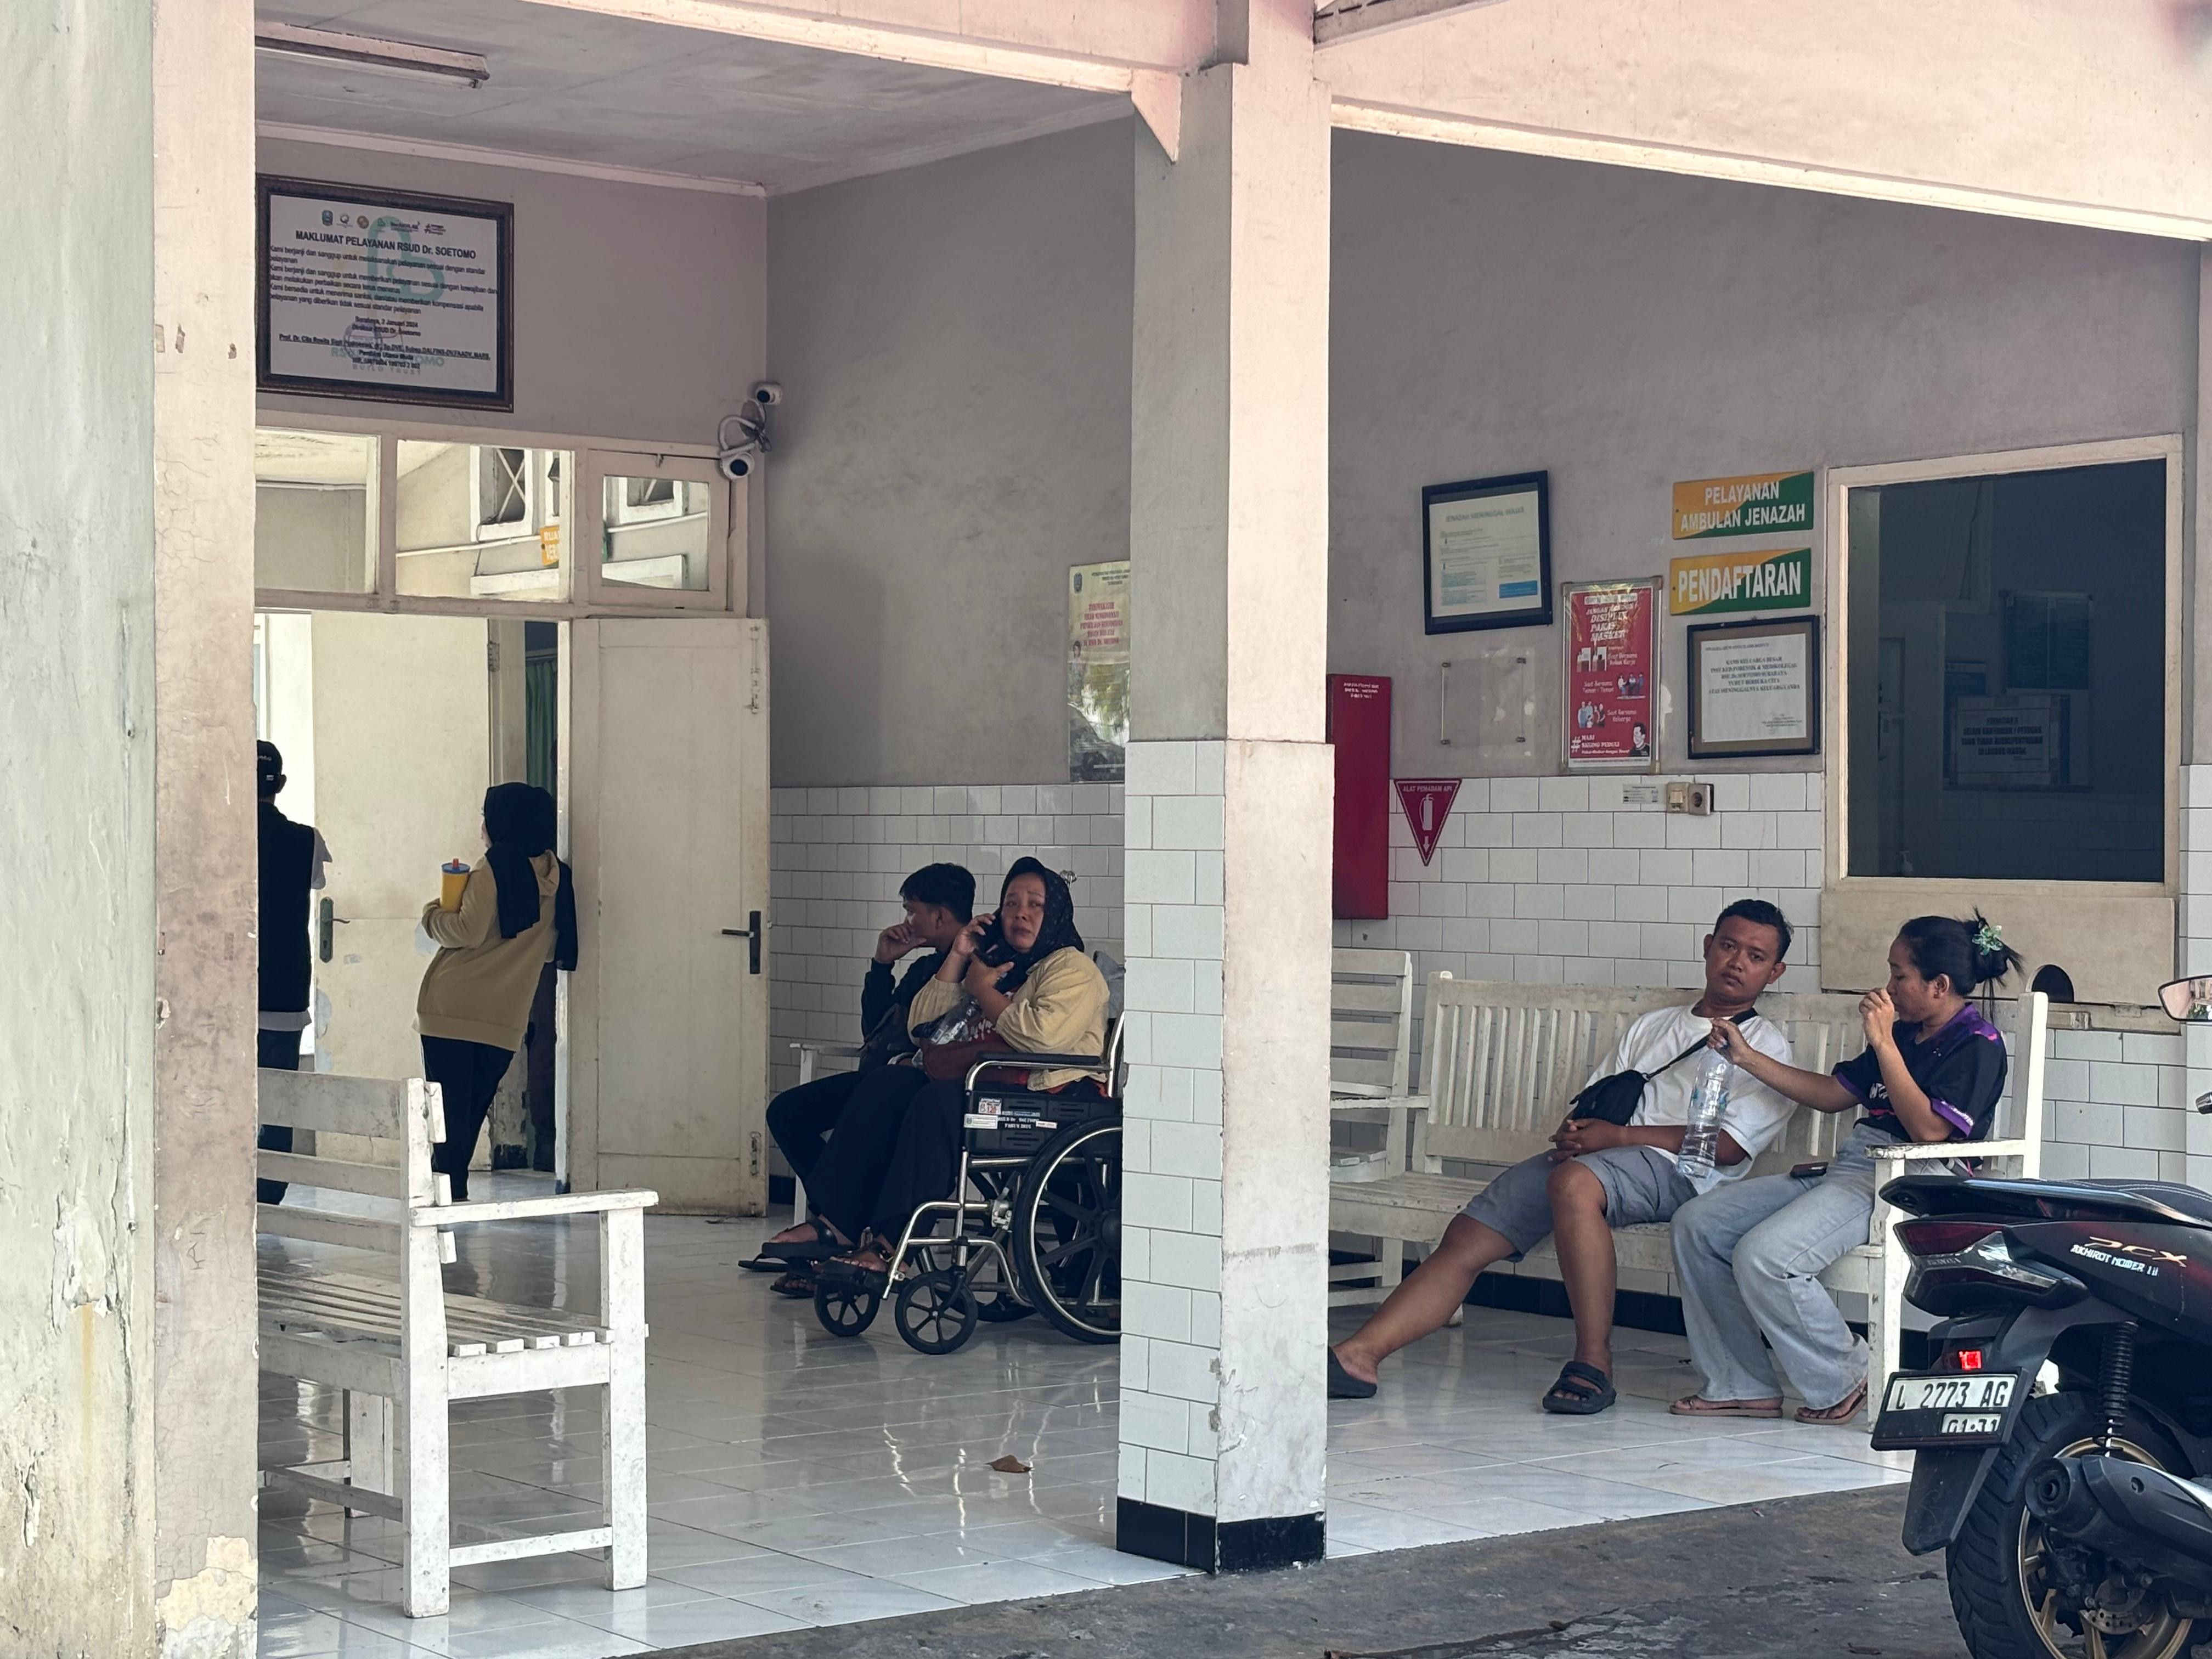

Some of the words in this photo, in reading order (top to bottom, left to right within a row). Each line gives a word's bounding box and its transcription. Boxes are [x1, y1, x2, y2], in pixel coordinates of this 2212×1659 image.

[296, 230, 344, 245] MAKLUMAT
[346, 236, 396, 250] PELAYANAN
[397, 241, 420, 253] RSUD
[422, 246, 433, 255] Dr.
[435, 246, 476, 259] SOETOMO
[285, 247, 305, 256] berjanji
[318, 251, 342, 260] sanggup
[398, 259, 426, 268] pelayanan
[445, 264, 465, 273] dengan
[285, 267, 305, 275] berjanji
[318, 270, 341, 279] sanggup
[393, 278, 420, 286] pelayanan
[440, 282, 460, 291] dengan
[460, 284, 486, 294] kewajiban
[285, 285, 308, 294] bersedia
[326, 289, 353, 298] menerima
[432, 300, 464, 309] kompensasi
[313, 298, 339, 306] diberikan
[393, 304, 421, 314] pelayanan
[1705, 481, 1779, 505] PELAYANAN
[1681, 510, 1741, 532] AMBULAN
[1745, 503, 1805, 527] JENAZAH
[1679, 561, 1801, 603] PENDAFTARAN
[2084, 1236, 2187, 1268] PCX
[1896, 1385, 1905, 1409] L
[1921, 1381, 1970, 1408] 2773
[1979, 1381, 2008, 1407] AG
